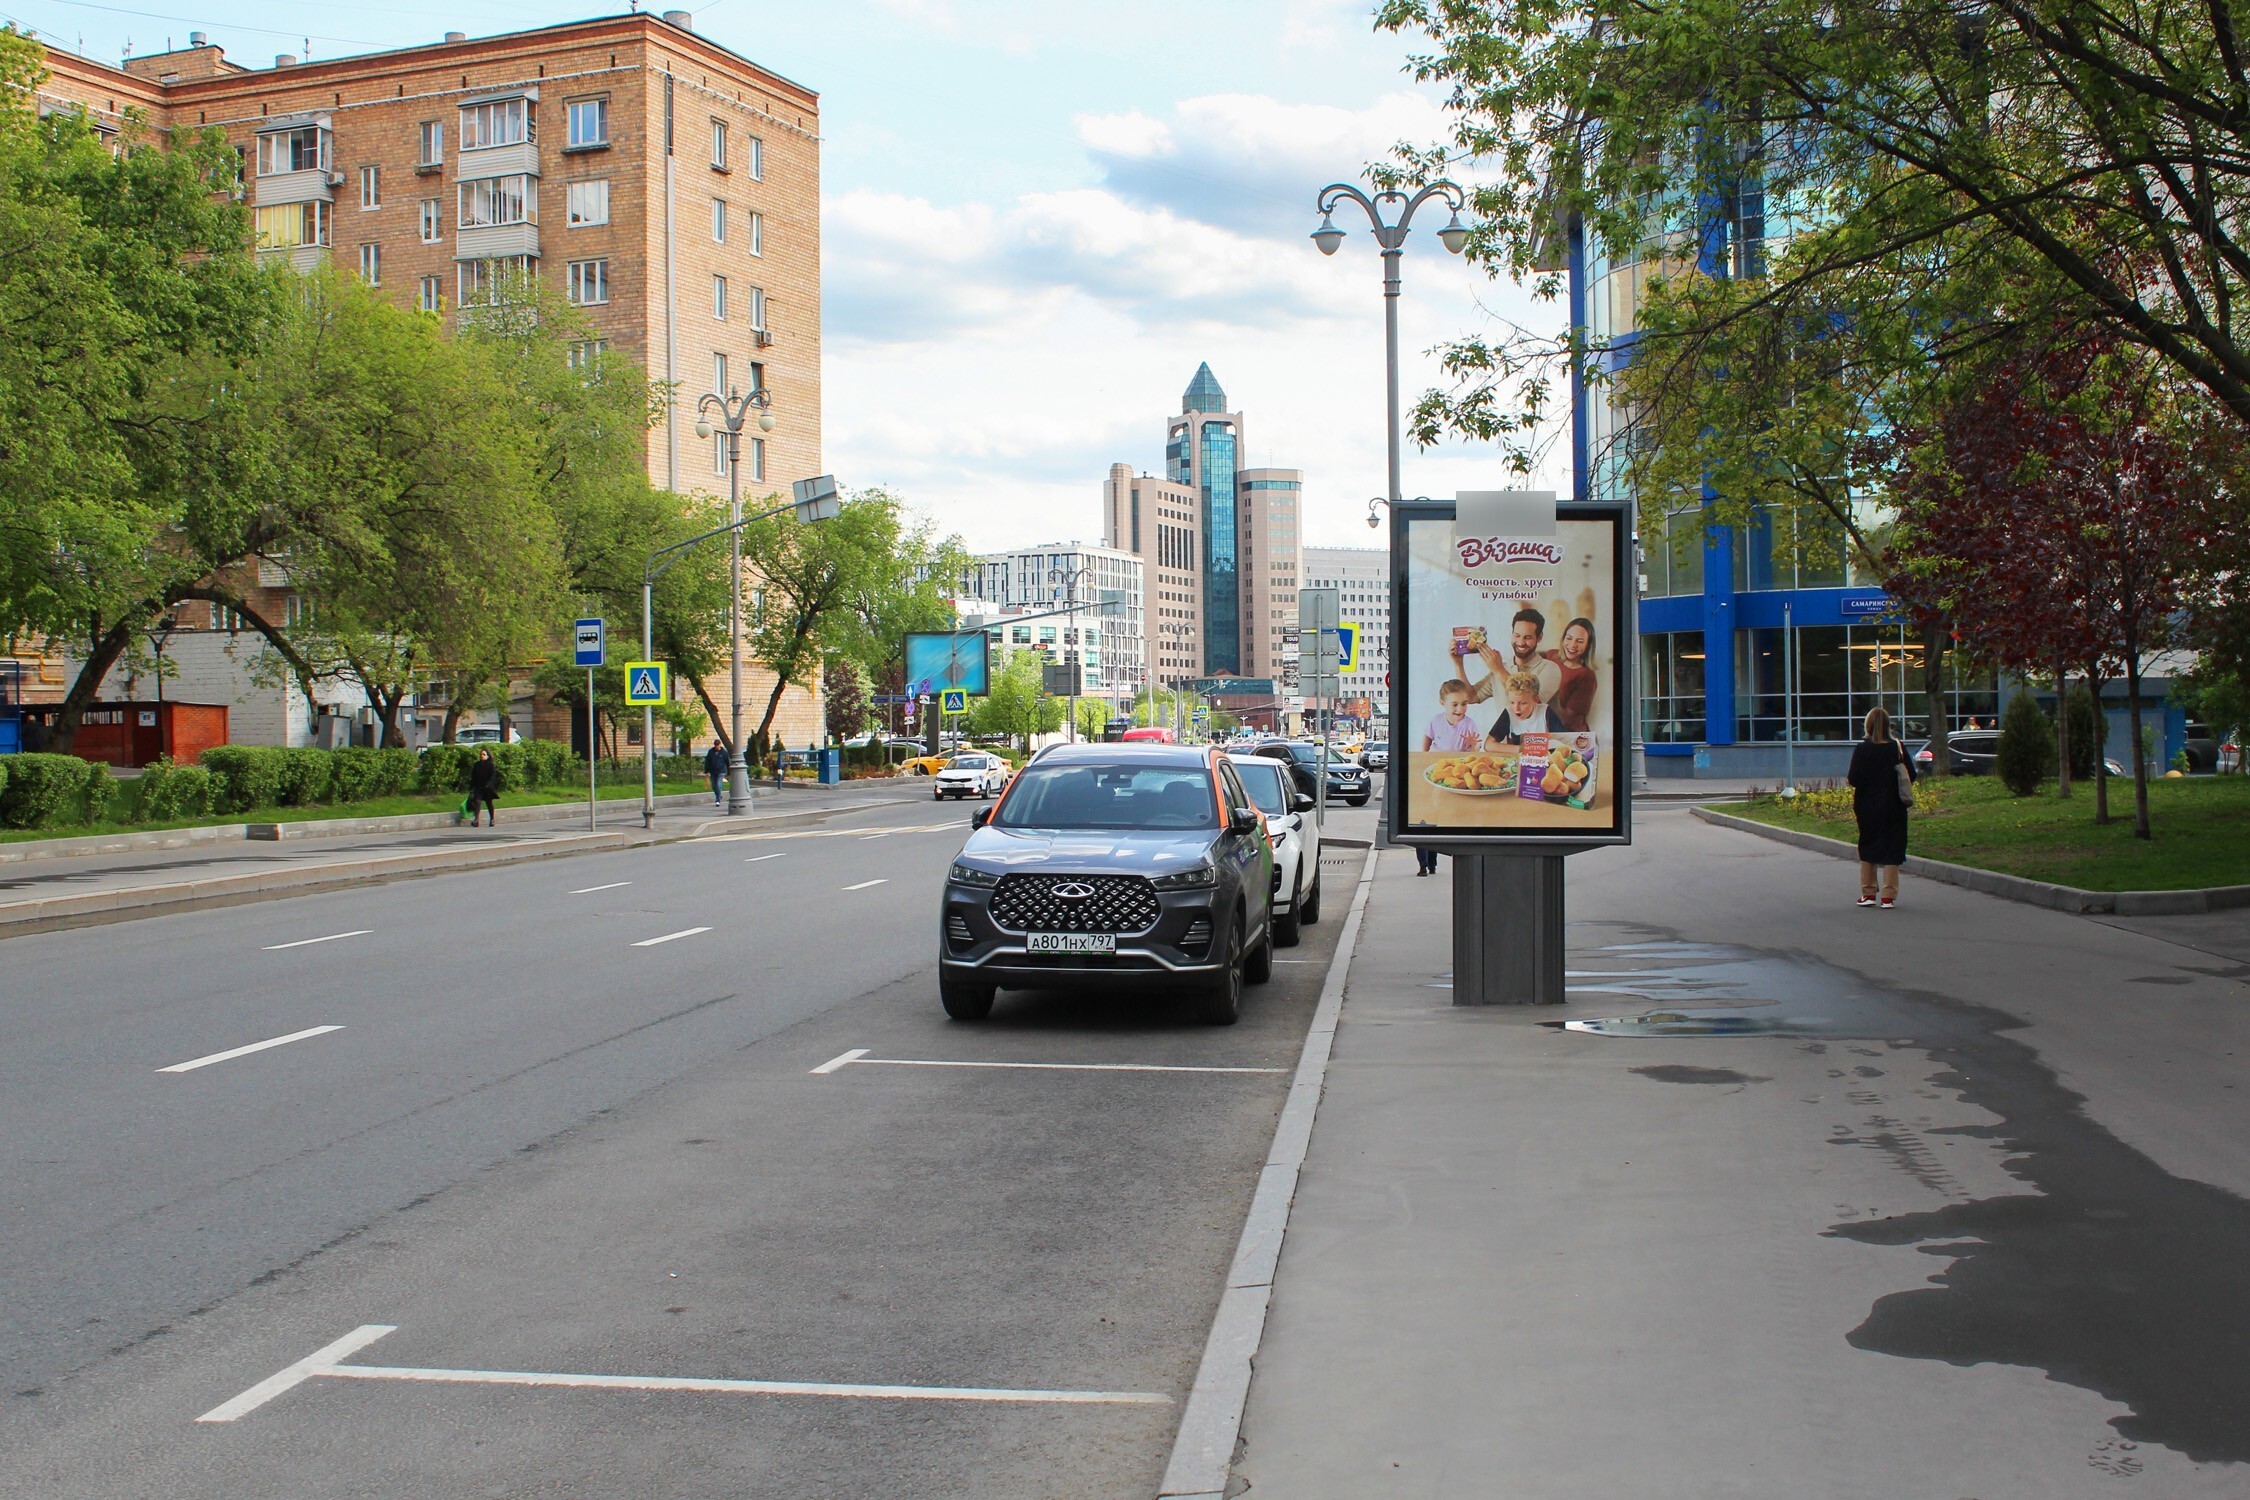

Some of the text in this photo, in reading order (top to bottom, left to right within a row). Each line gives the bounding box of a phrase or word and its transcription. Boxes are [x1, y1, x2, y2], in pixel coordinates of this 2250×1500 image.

[1466, 578, 1554, 588] Сочность, хруст
[1492, 590, 1538, 601] улыбки!
[1090, 935, 1112, 946] 797
